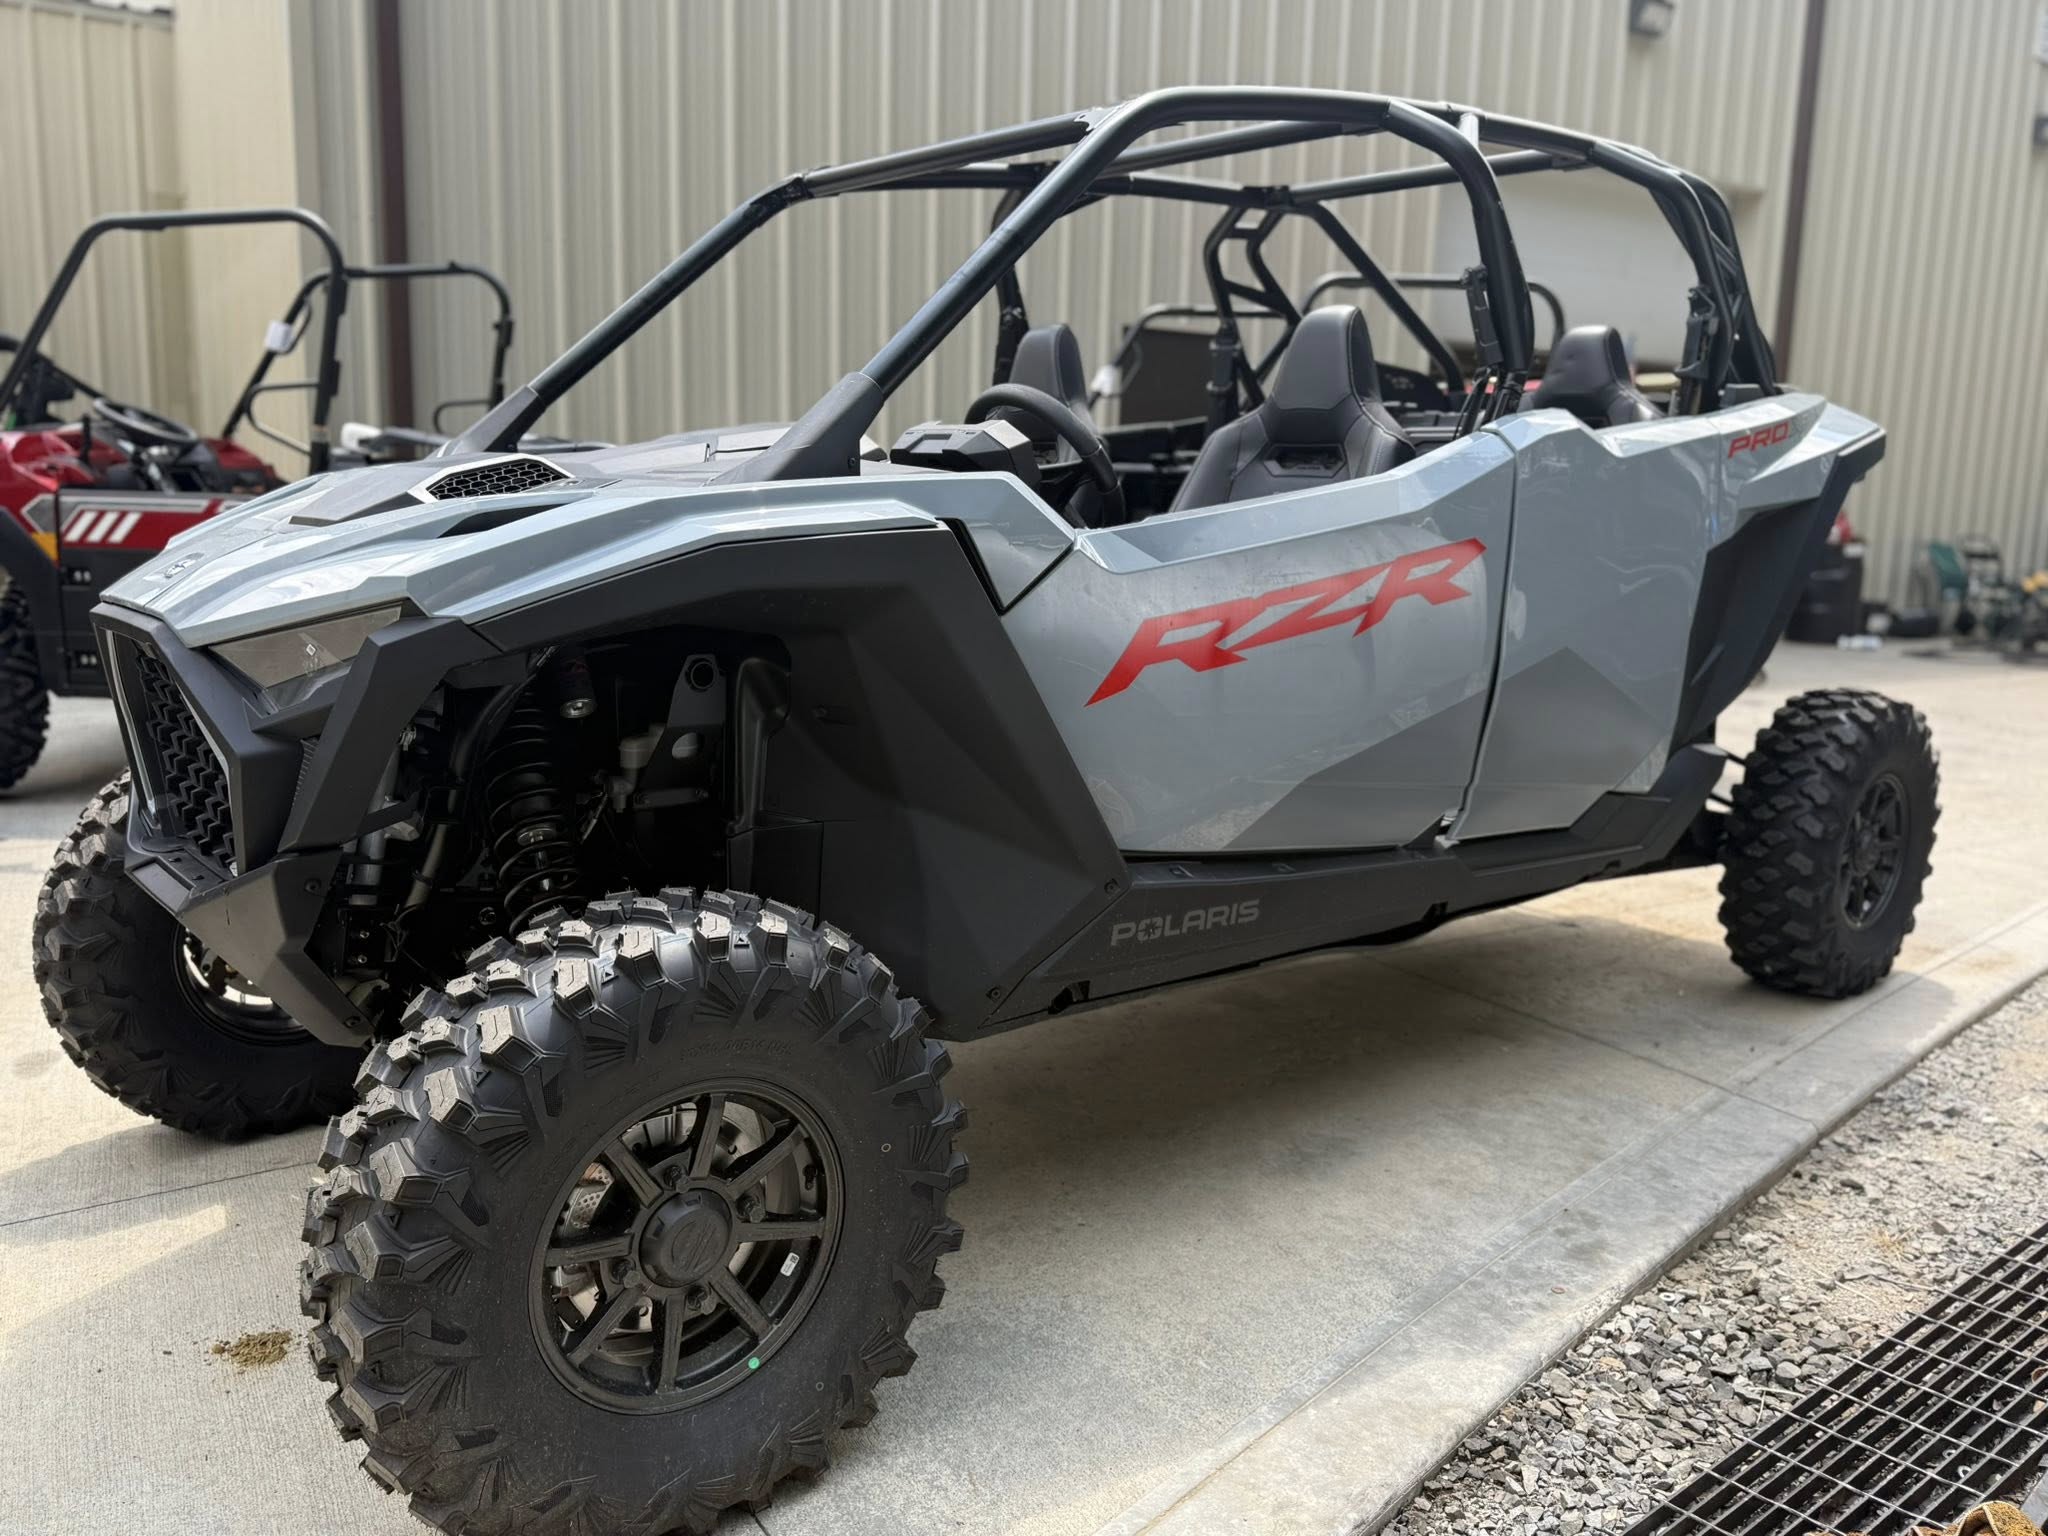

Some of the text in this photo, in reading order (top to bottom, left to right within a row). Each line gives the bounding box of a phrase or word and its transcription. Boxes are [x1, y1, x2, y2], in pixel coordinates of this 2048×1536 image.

[1727, 421, 1789, 459] PRO
[1083, 537, 1487, 708] RZR
[1110, 899, 1260, 946] POLARIS
